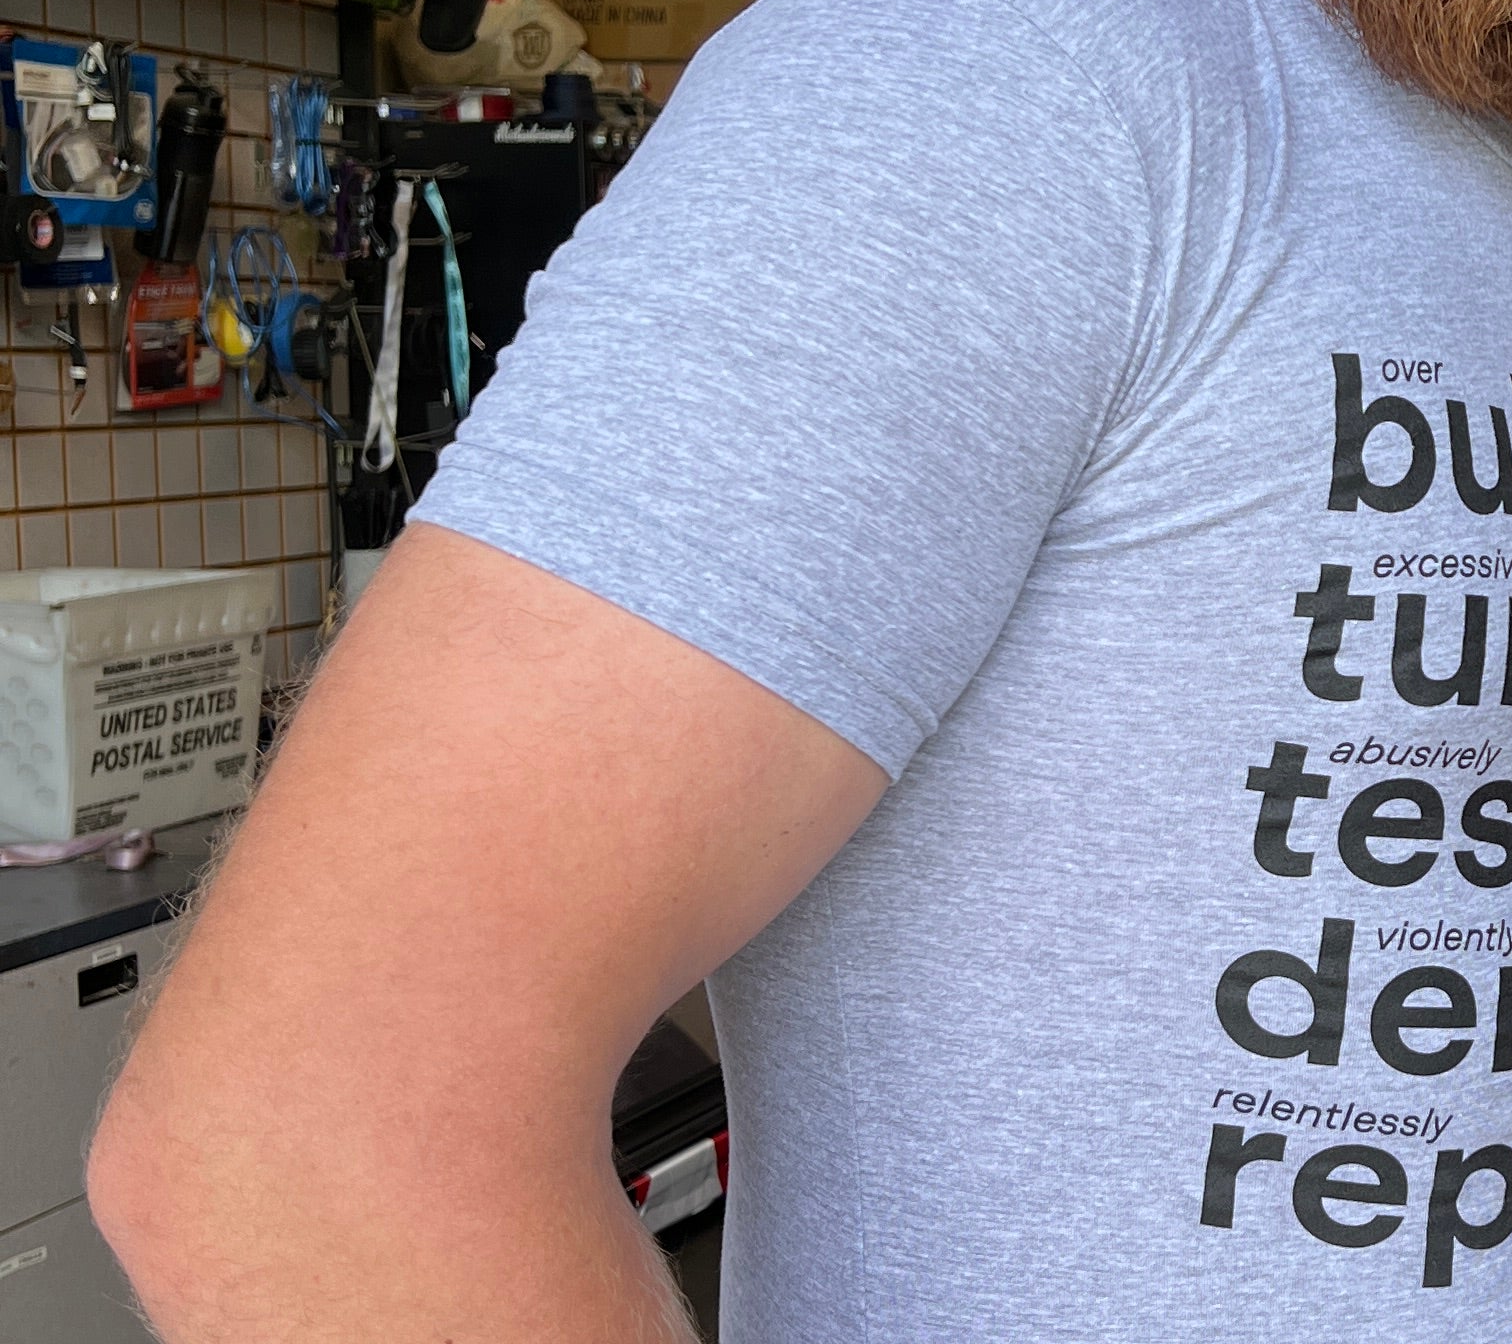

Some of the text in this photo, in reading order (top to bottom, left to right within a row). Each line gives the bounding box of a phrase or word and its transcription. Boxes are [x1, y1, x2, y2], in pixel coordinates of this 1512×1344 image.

[1381, 357, 1444, 385] over
[100, 686, 238, 738] UNITED STATES
[91, 737, 165, 777] POSTAL
[170, 716, 244, 755] SERVICE
[1328, 735, 1503, 775] abusively
[1211, 1088, 1454, 1144] relentlessly
